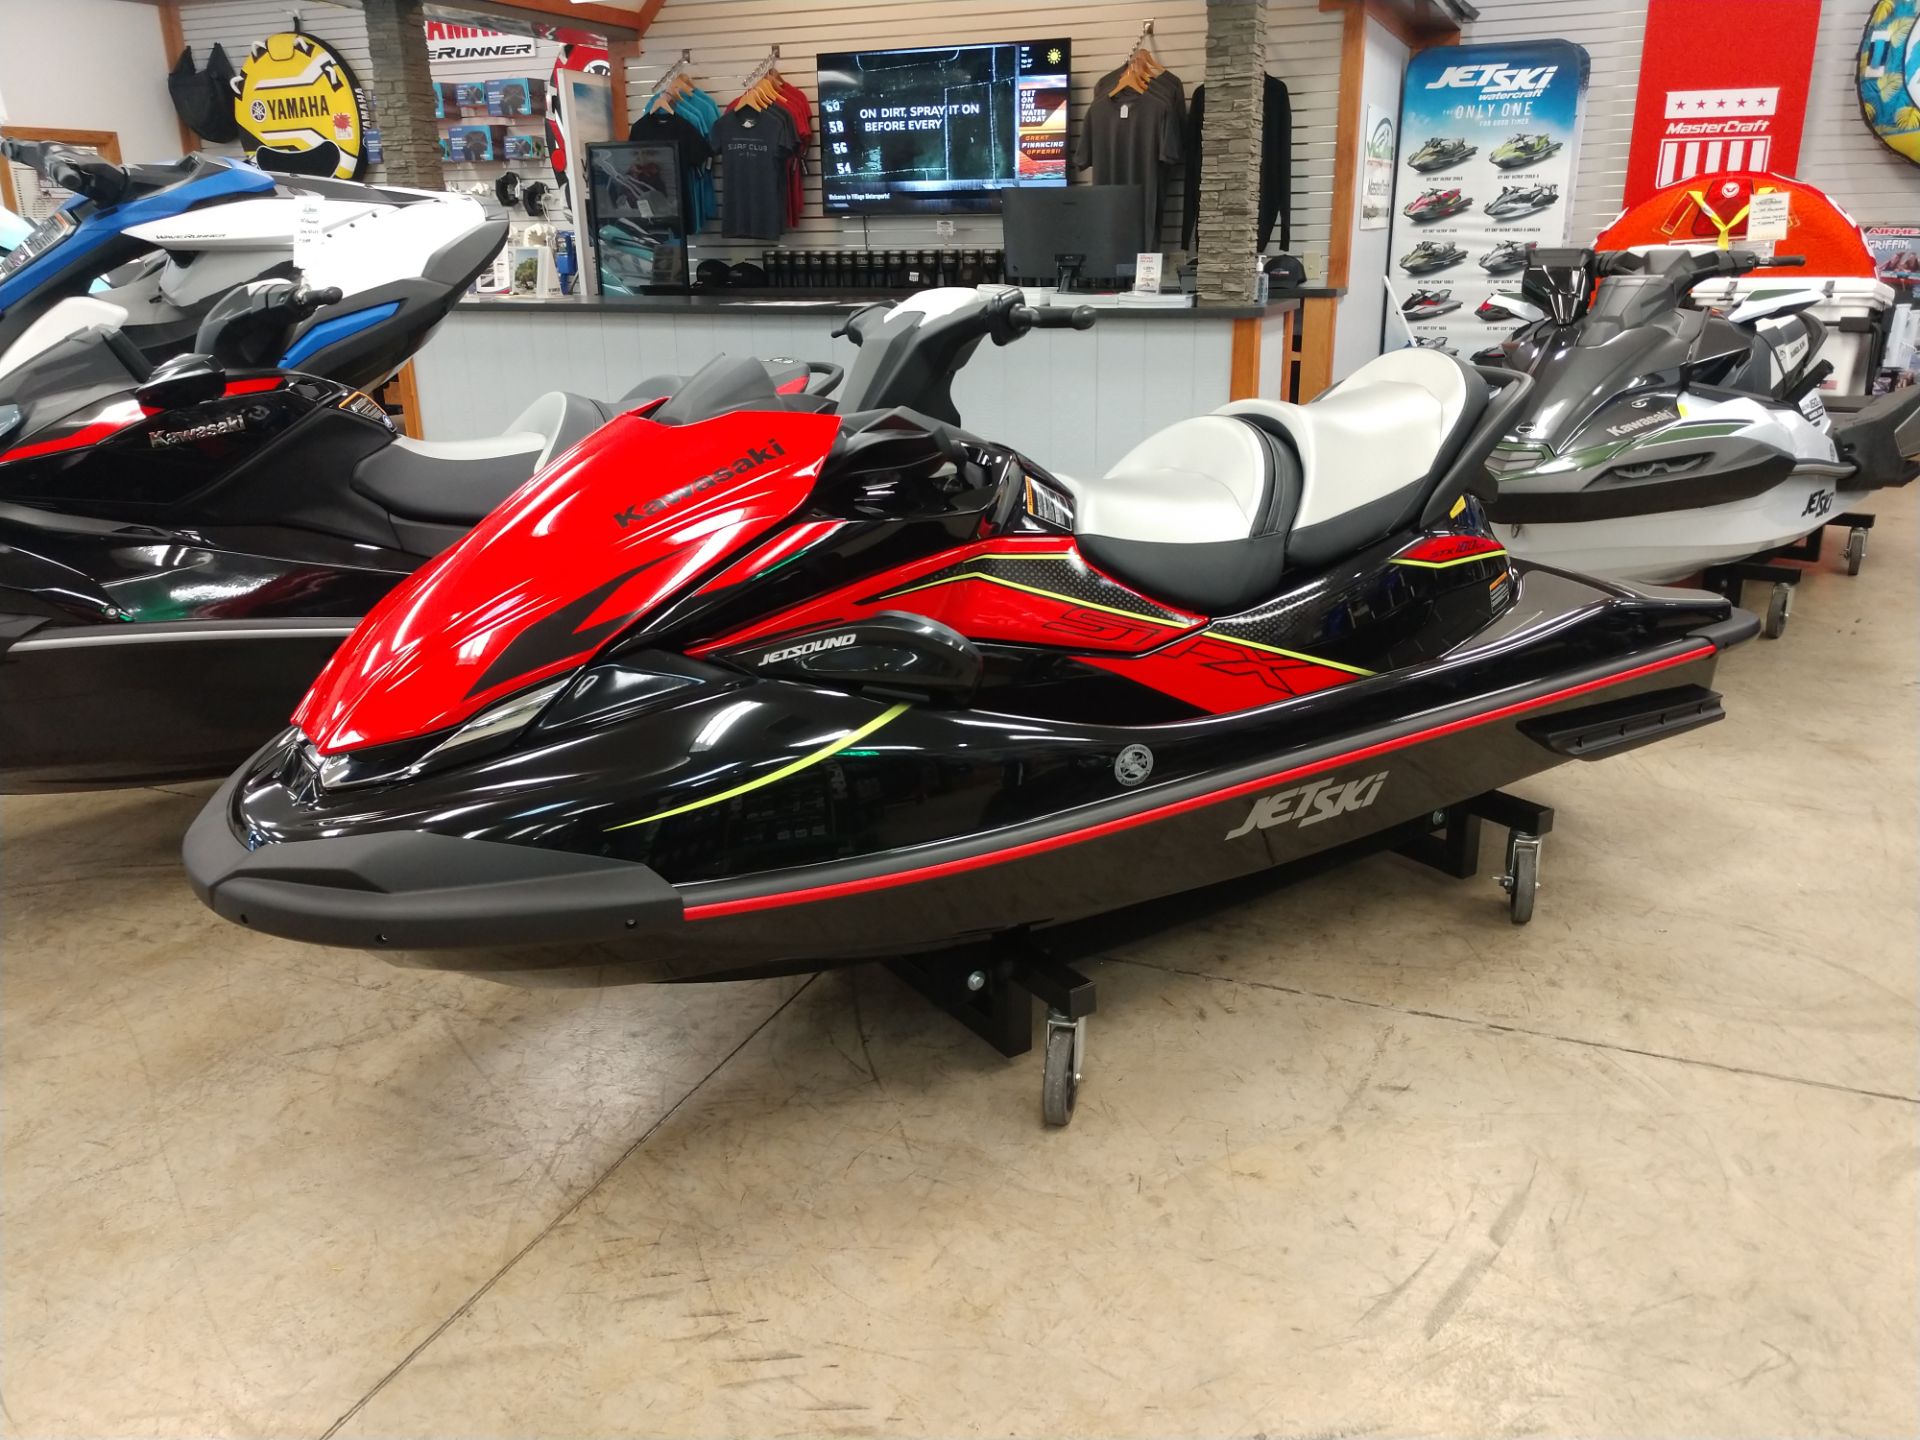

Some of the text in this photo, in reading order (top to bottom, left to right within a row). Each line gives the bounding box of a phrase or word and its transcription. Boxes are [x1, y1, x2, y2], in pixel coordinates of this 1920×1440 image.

[1478, 89, 1543, 101] watercraft
[267, 95, 330, 120] YAMAHA
[859, 103, 980, 119] ON DIRT, SPRAY IT ON
[1455, 103, 1496, 119] ONLY
[1501, 101, 1534, 116] ONE
[864, 119, 943, 132] BEFORE EVERY
[1021, 115, 1047, 123] TODAY
[828, 120, 844, 133] 58
[1665, 119, 1770, 135] MasterCraft
[727, 143, 768, 152] SURF CLUB
[832, 142, 848, 155] 56
[1021, 141, 1064, 149] FINANCING
[836, 162, 852, 174] 54
[1606, 409, 1677, 437] Kawasaki
[148, 413, 247, 448] Kawasaki
[613, 438, 787, 529] Kawasaki
[757, 633, 857, 667] JETSOUND
